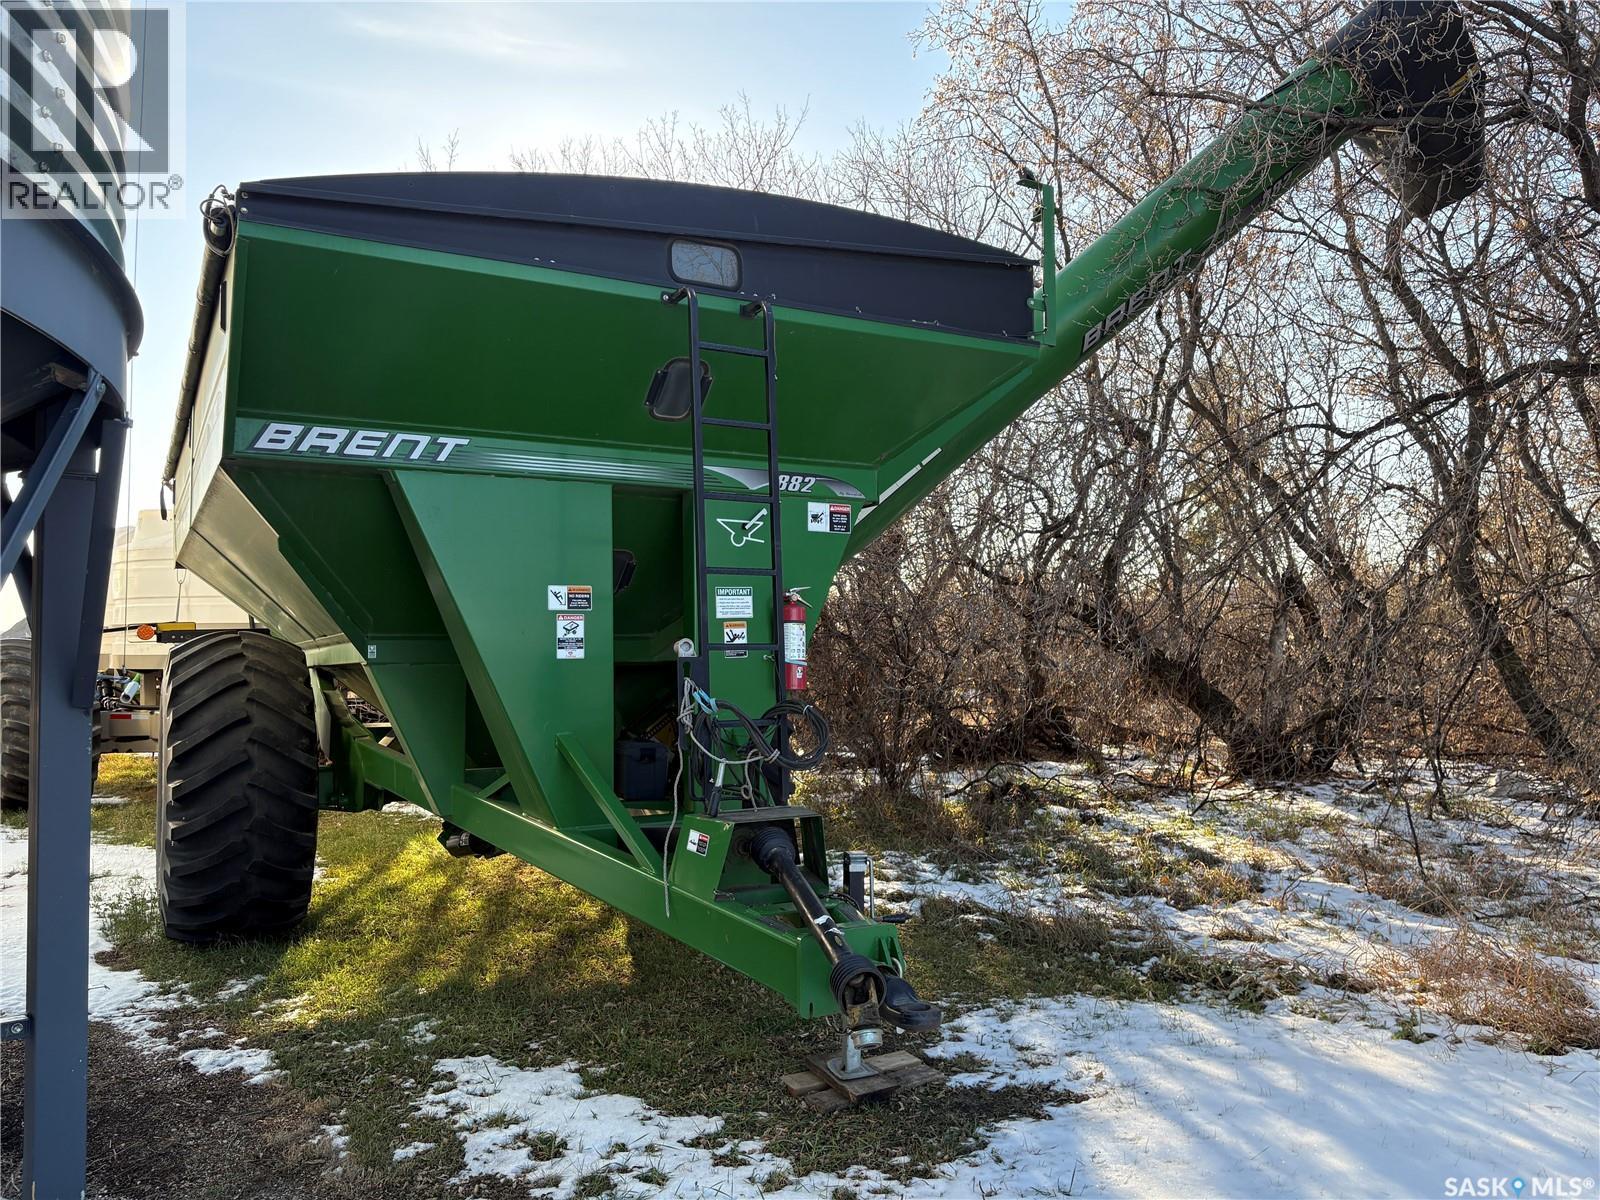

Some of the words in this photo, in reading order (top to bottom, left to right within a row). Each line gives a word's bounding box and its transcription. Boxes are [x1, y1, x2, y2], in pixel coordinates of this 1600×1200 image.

[1083, 248, 1192, 353] BRENT
[253, 422, 471, 462] BRENT
[778, 474, 816, 493] 882
[717, 588, 750, 596] IMPORTANT
